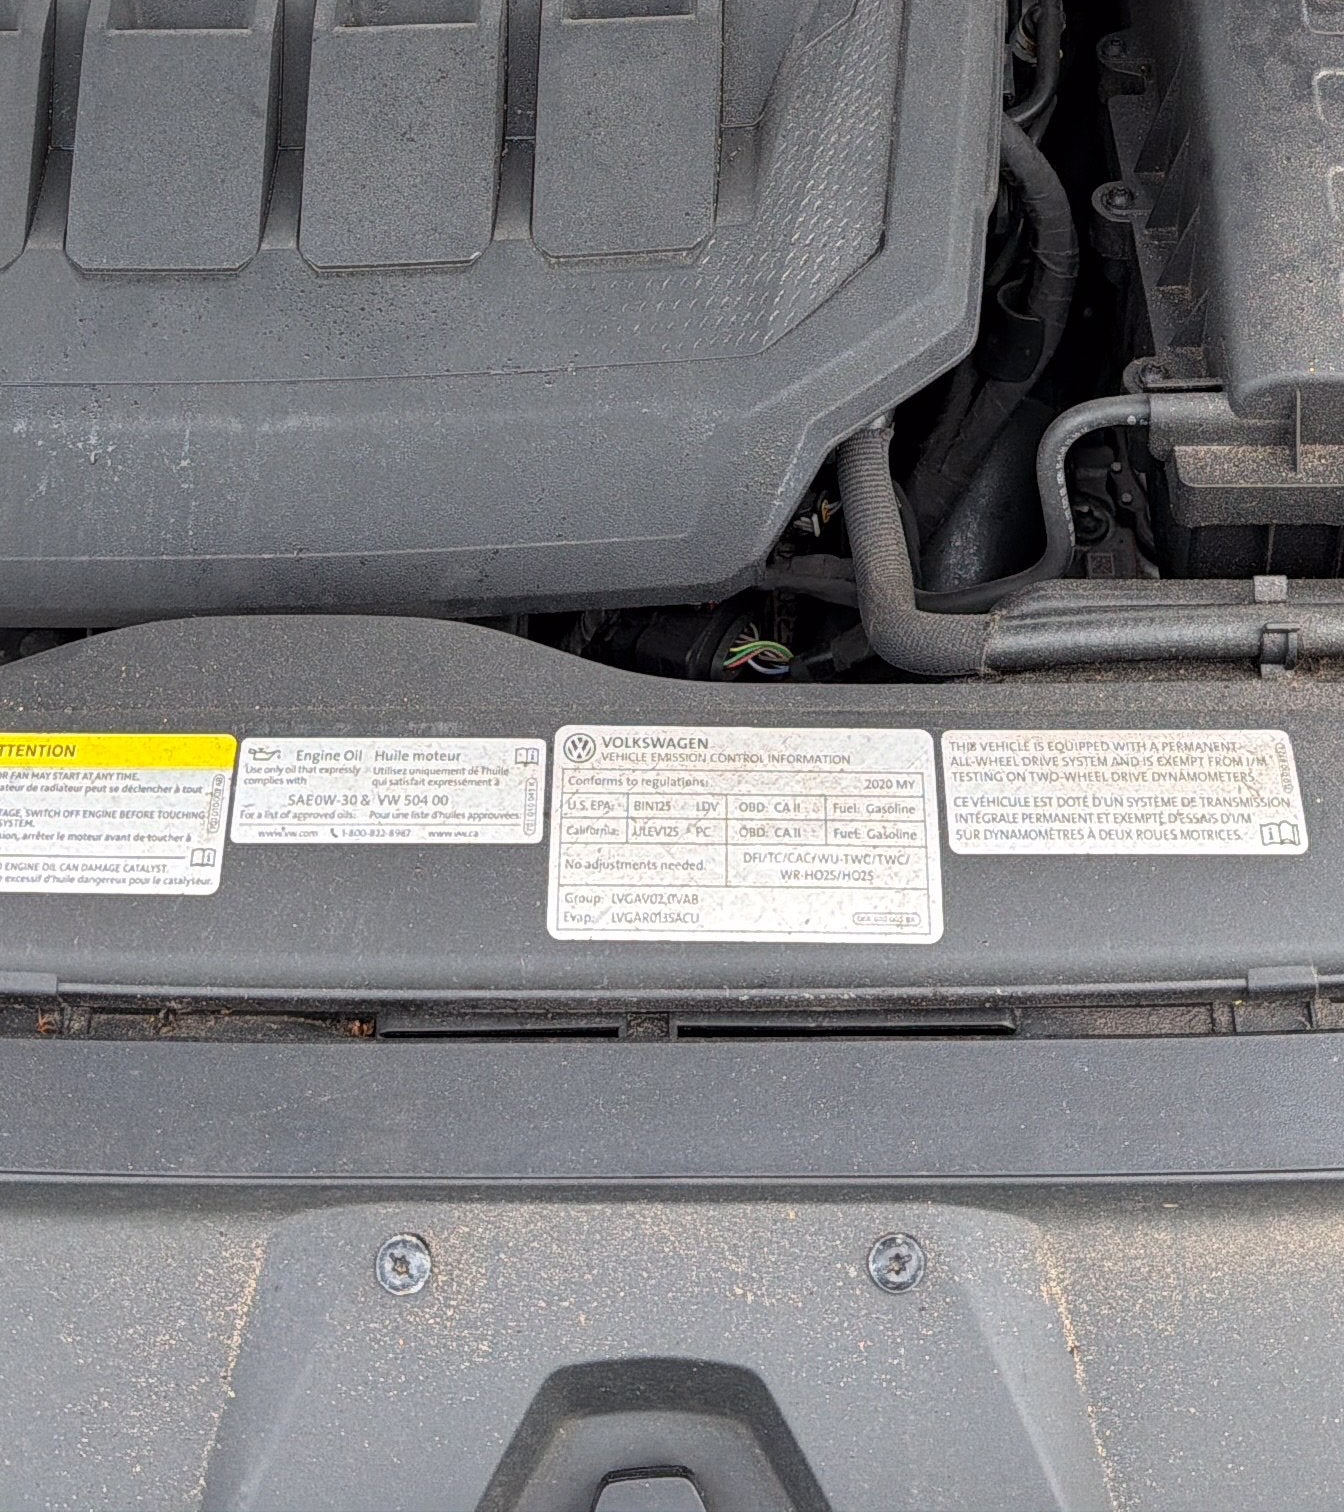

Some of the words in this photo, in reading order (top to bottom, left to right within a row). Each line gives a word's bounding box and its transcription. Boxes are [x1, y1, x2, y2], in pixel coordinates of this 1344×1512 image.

[601, 736, 708, 750] VOLKSWAGEN
[979, 741, 1030, 752] VEHICLE
[1033, 741, 1044, 752] IS
[1046, 741, 1110, 753] EQUIPPED
[1112, 741, 1147, 752] WITH
[1148, 741, 1159, 752] A
[1160, 741, 1237, 752] PERMANENT
[295, 749, 340, 764] Engine
[343, 749, 362, 761] Oil
[374, 749, 409, 761] Huile
[412, 750, 461, 762] moteur
[600, 751, 647, 762] VEHICLE
[650, 752, 706, 763] EMISSION
[709, 752, 764, 764] CONTROL
[767, 753, 851, 764] INFORMATION
[949, 755, 1019, 767] ALL-WHEEL
[1020, 755, 1059, 767] DRIVE
[1060, 755, 1108, 767] SYSTEM
[1109, 756, 1139, 767] AND
[1142, 756, 1154, 767] IS
[1156, 756, 1205, 767] EXEMPT
[1207, 756, 1243, 767] FROM
[1245, 756, 1267, 767] I/M
[10, 771, 29, 779] FAN
[31, 771, 49, 779] MAY
[53, 771, 80, 780] START
[82, 772, 92, 780] AT
[95, 772, 114, 780] ANY
[116, 772, 140, 780] TIME.
[244, 764, 262, 774] Use
[263, 764, 284, 776] only
[284, 764, 296, 774] oil
[297, 764, 317, 774] that
[317, 764, 361, 776] expressly
[372, 766, 407, 775] Utilisez
[408, 766, 465, 776] uniquement
[242, 775, 284, 786] complies
[285, 775, 307, 785] with
[567, 775, 623, 786] Conforms
[626, 776, 638, 786] to
[950, 771, 1003, 782] TESTING
[1004, 771, 1026, 782] ON
[1028, 771, 1108, 782] TWO-WHEEL
[1110, 771, 1148, 782] DRIVE
[371, 777, 387, 789] qui
[388, 777, 425, 786] satisfait
[426, 777, 492, 788] expressément
[493, 777, 500, 786] à
[863, 778, 893, 789] 2020
[895, 779, 916, 789] MY
[287, 793, 358, 806] SAE0W-30
[359, 794, 371, 806] &
[376, 794, 401, 806] VW
[403, 794, 428, 806] 504
[431, 794, 449, 806] 00
[952, 796, 969, 807] CE
[969, 794, 1031, 807] VÉHICULE
[1032, 796, 1054, 807] EST
[1055, 794, 1089, 807] DOTÉ
[1091, 796, 1124, 807] D'UN
[1125, 794, 1178, 807] SYSTÈME
[1179, 796, 1198, 807] DE
[1198, 796, 1291, 807] TRANSMISSION
[633, 800, 672, 811] BIN125
[695, 801, 719, 812] LDV
[738, 801, 768, 813] OBD:
[773, 801, 790, 813] CA
[793, 802, 801, 813] II
[832, 802, 860, 813] Fuel:
[865, 803, 916, 814] Gasoline
[25, 809, 61, 818] SWITCH
[62, 809, 80, 818] OFF
[82, 809, 119, 818] ENGINE
[119, 810, 155, 819] BEFORE
[157, 810, 205, 820] TOUCHING
[954, 810, 1019, 824] INTÉGRALE
[1020, 812, 1095, 824] PERMANENT
[1095, 812, 1111, 824] ET
[1111, 811, 1167, 824] EXEMPTÉ
[631, 825, 679, 837] ULEV125
[695, 826, 711, 837] PC
[738, 826, 768, 838] OBD:
[773, 827, 791, 838] CA
[793, 827, 801, 838] II
[832, 827, 861, 839] Fuel:
[865, 828, 917, 840] Gasoline
[955, 828, 980, 840] SUR
[982, 826, 1084, 840] DYNAMOMÈTRES
[1085, 826, 1096, 840] À
[1097, 828, 1133, 840] DEUX
[1135, 828, 1177, 840] ROUES
[564, 858, 582, 869] No
[583, 858, 657, 873] adjustments
